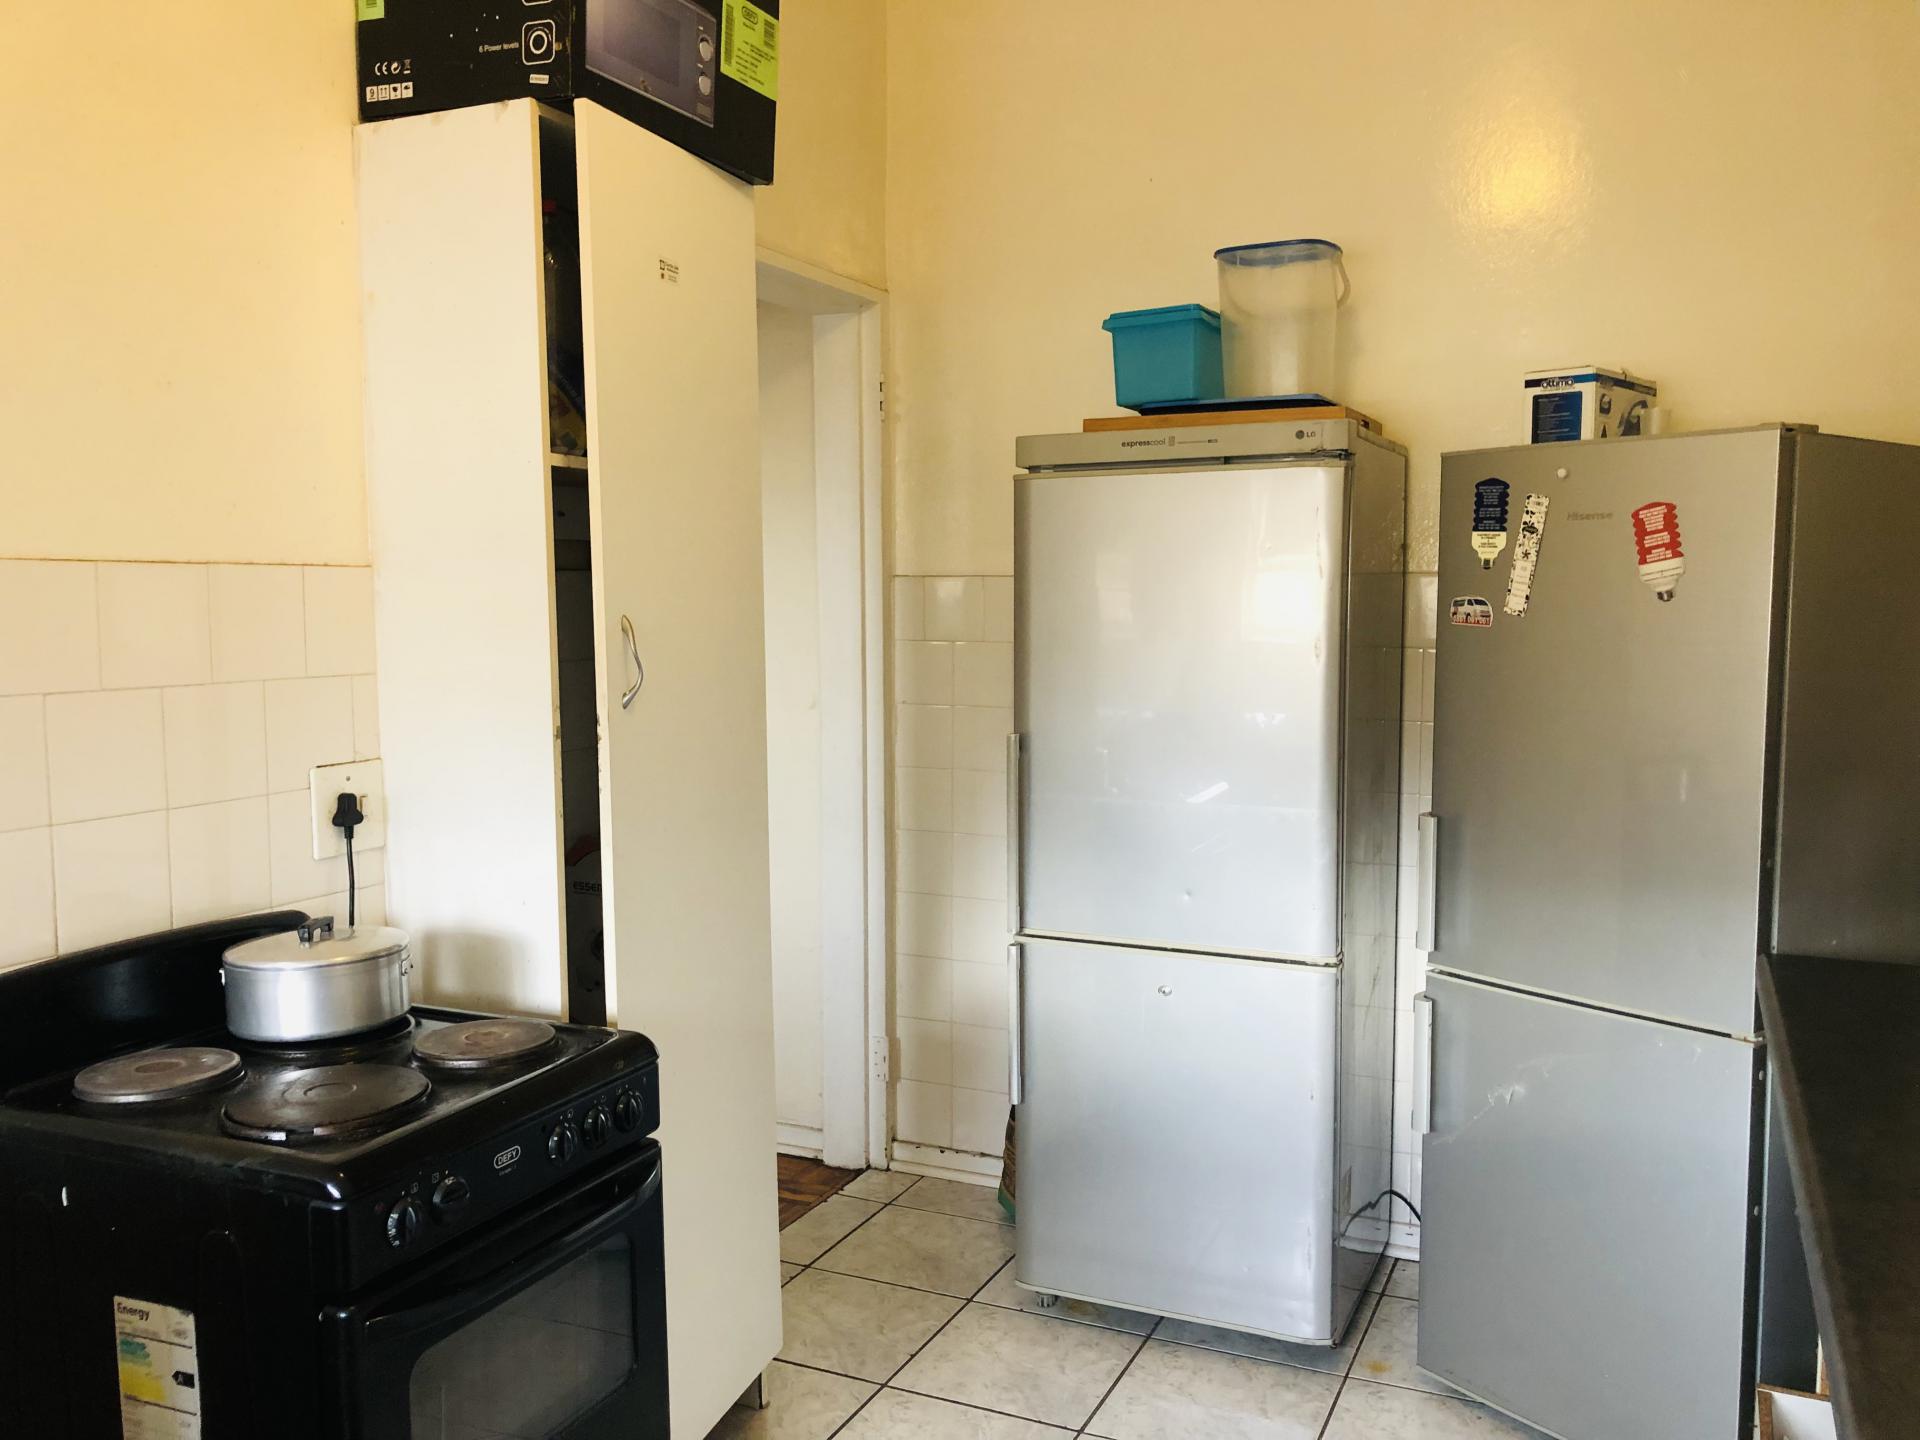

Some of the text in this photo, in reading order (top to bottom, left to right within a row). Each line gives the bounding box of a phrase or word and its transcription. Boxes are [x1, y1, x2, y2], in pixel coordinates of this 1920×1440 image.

[484, 44, 502, 53] Power
[503, 42, 520, 50] levels
[1121, 437, 1166, 449] expresscool
[1567, 511, 1613, 521] Hisense
[497, 1149, 517, 1166] DEFY
[117, 1302, 150, 1322] Energy
